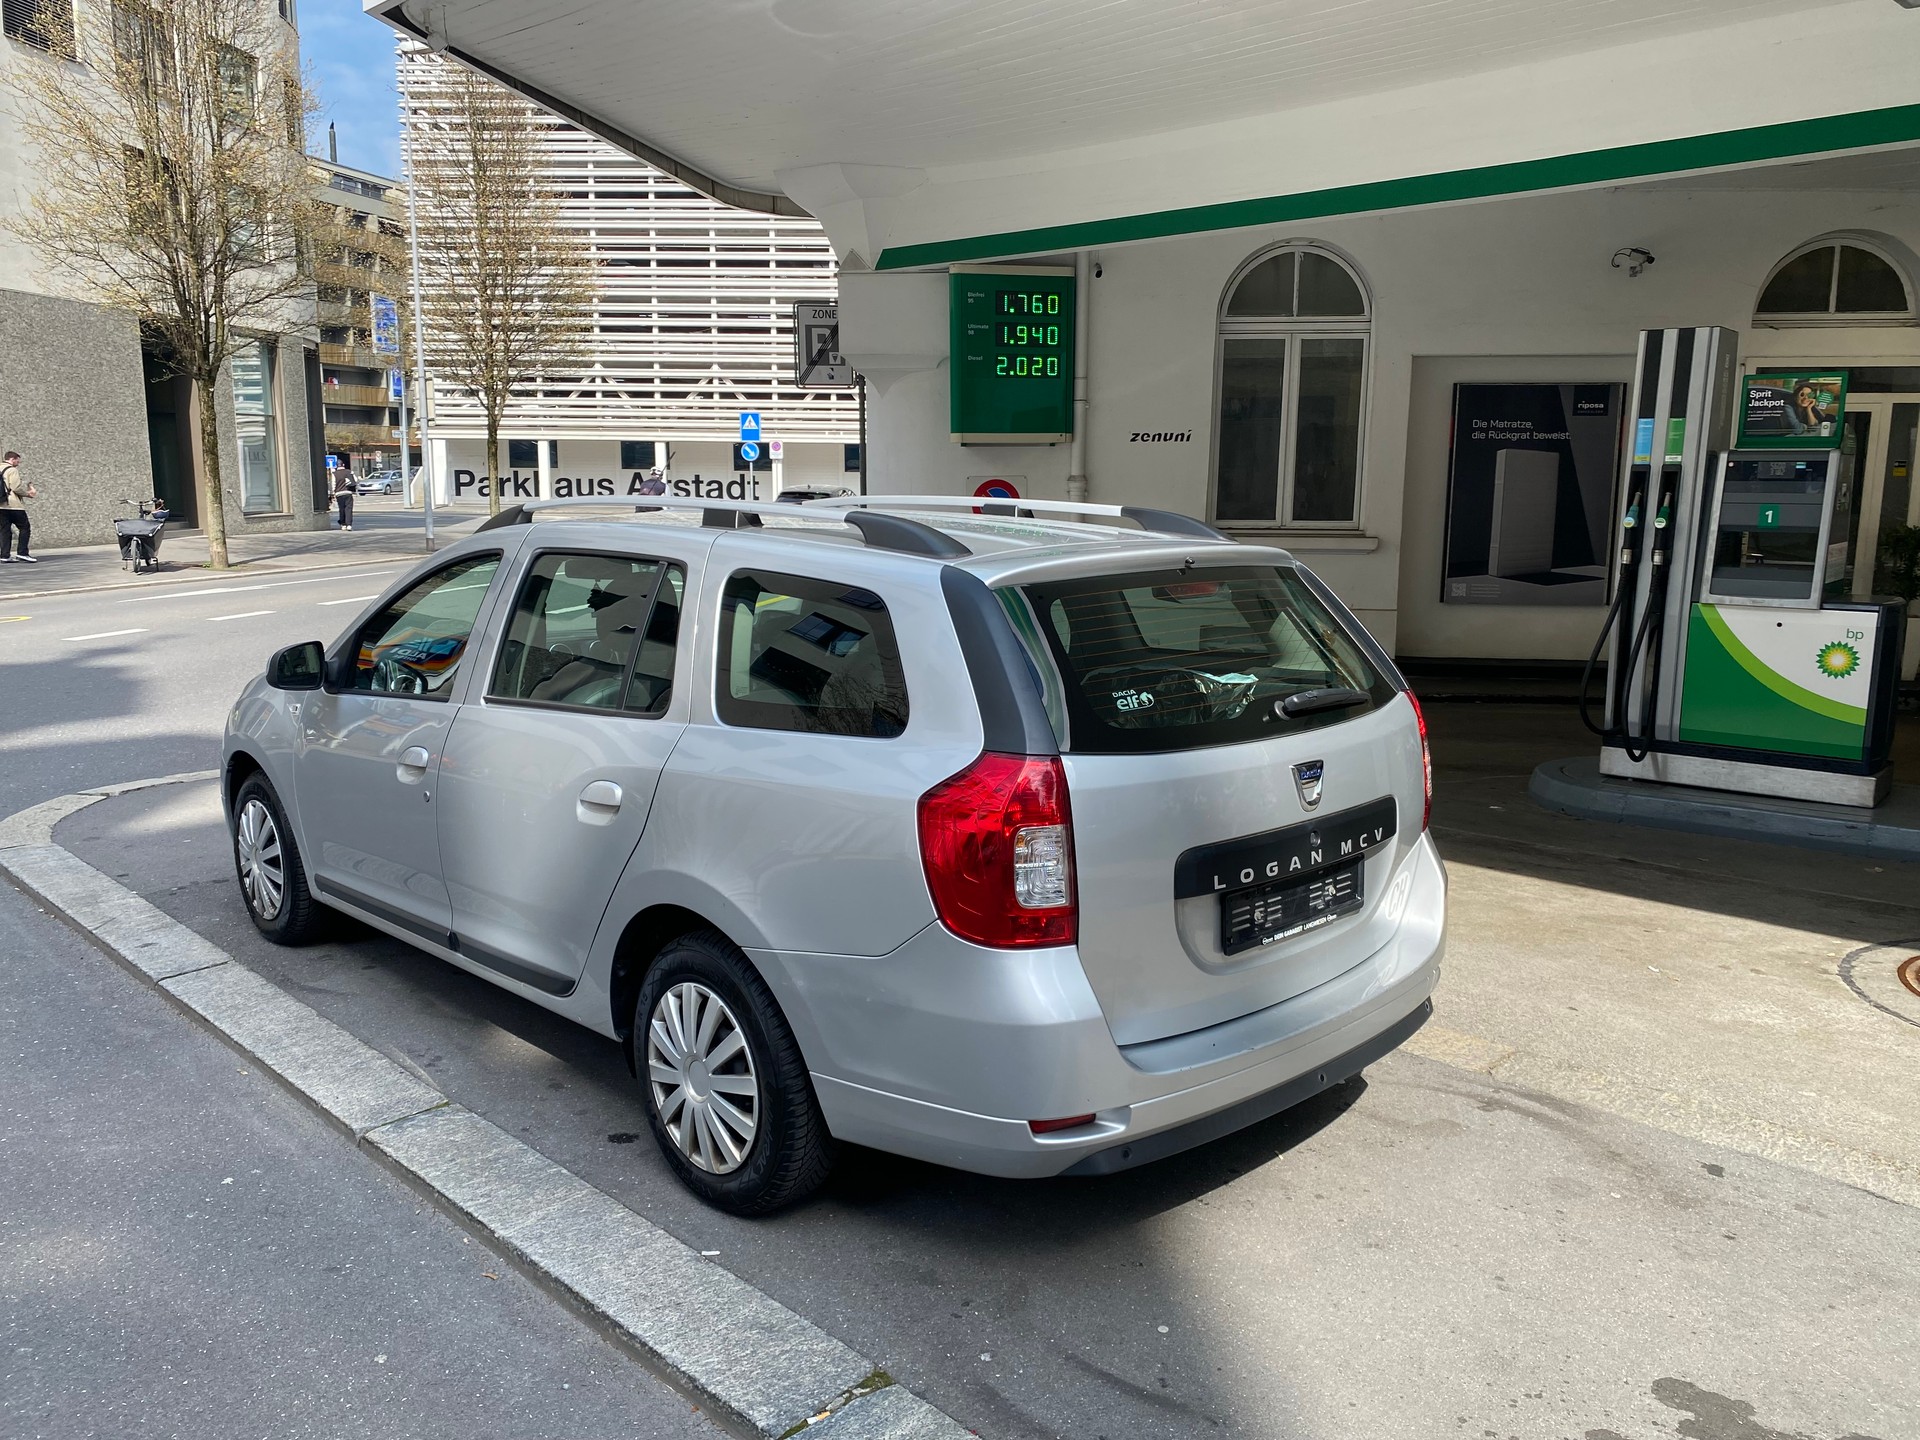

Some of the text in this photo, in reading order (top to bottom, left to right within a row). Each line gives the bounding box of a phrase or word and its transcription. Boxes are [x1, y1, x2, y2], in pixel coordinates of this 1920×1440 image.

[1003, 294, 1059, 314] 1.760
[812, 309, 837, 319] ZONE
[1003, 326, 1059, 345] 1.940
[996, 356, 1058, 376] 2.020
[1749, 389, 1772, 399] Sprit
[1577, 401, 1604, 410] riposa
[1748, 398, 1784, 408] Jackpot
[1472, 419, 1534, 430] Die Matratze,
[1130, 429, 1192, 443] zenuni
[1471, 430, 1571, 442] die Rückgrat beweist.
[627, 471, 759, 501] Astadt
[1765, 510, 1773, 523] 1
[1846, 628, 1864, 641] bp
[1112, 689, 1137, 698] DACIA
[1116, 694, 1140, 710] elf
[1213, 827, 1384, 890] LOGAN MCV
[1388, 874, 1409, 917] CH
